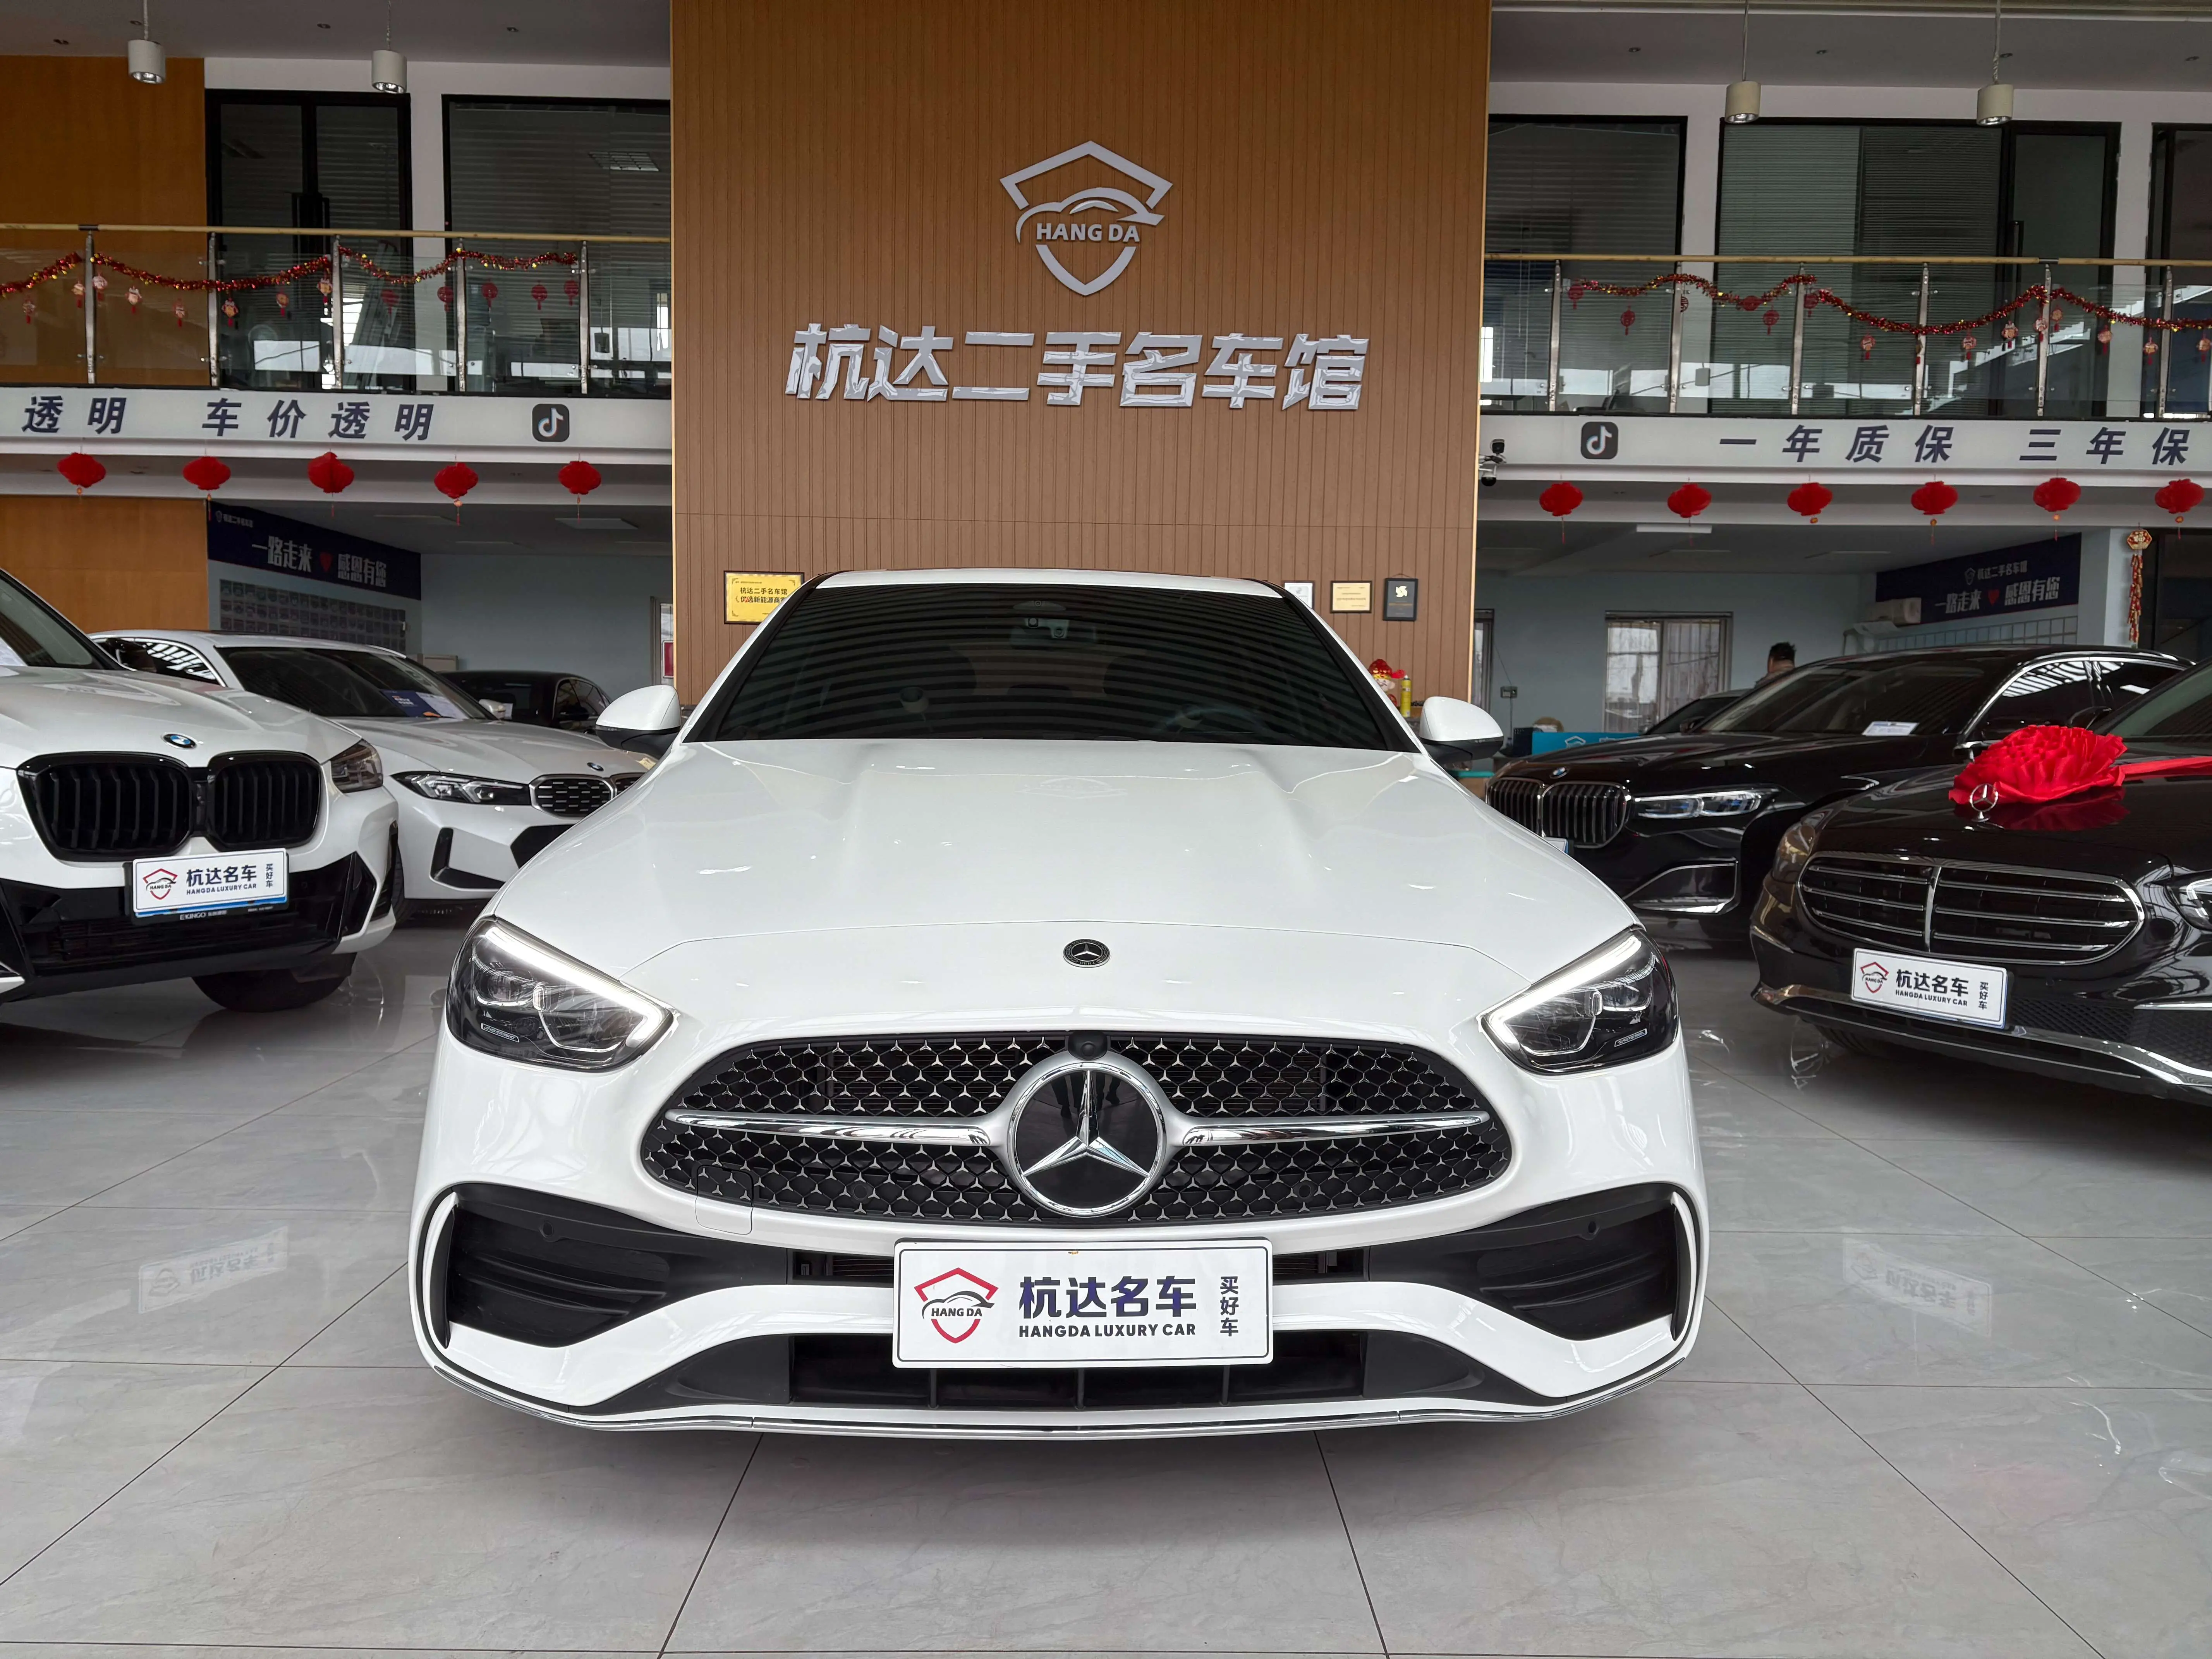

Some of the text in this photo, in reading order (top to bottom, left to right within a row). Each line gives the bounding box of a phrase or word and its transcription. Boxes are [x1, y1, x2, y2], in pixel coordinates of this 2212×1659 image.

[1036, 222, 1140, 243] HANG DA
[785, 323, 1369, 410] 杭达二手名车馆
[21, 395, 434, 441] 透明 车价透明
[1719, 424, 2191, 465] 一年质保 三年保
[252, 535, 386, 587] 一路走来 感恩有您
[1935, 577, 2061, 614] 一路走来 感恩有您
[186, 865, 257, 887] 杭达名车
[186, 887, 215, 895] HANGDA
[1896, 969, 1969, 997] 杭达名车
[1896, 989, 1923, 1000] HANGDA
[1925, 994, 1951, 1003] LUXURY
[1978, 982, 1989, 1010] 买好车
[1019, 1276, 1197, 1319] 杭达名车
[1220, 1276, 1239, 1336] 买好车
[931, 1308, 982, 1317] HANG DA
[1019, 1324, 1195, 1337] HANGDA LUXURY CAR
